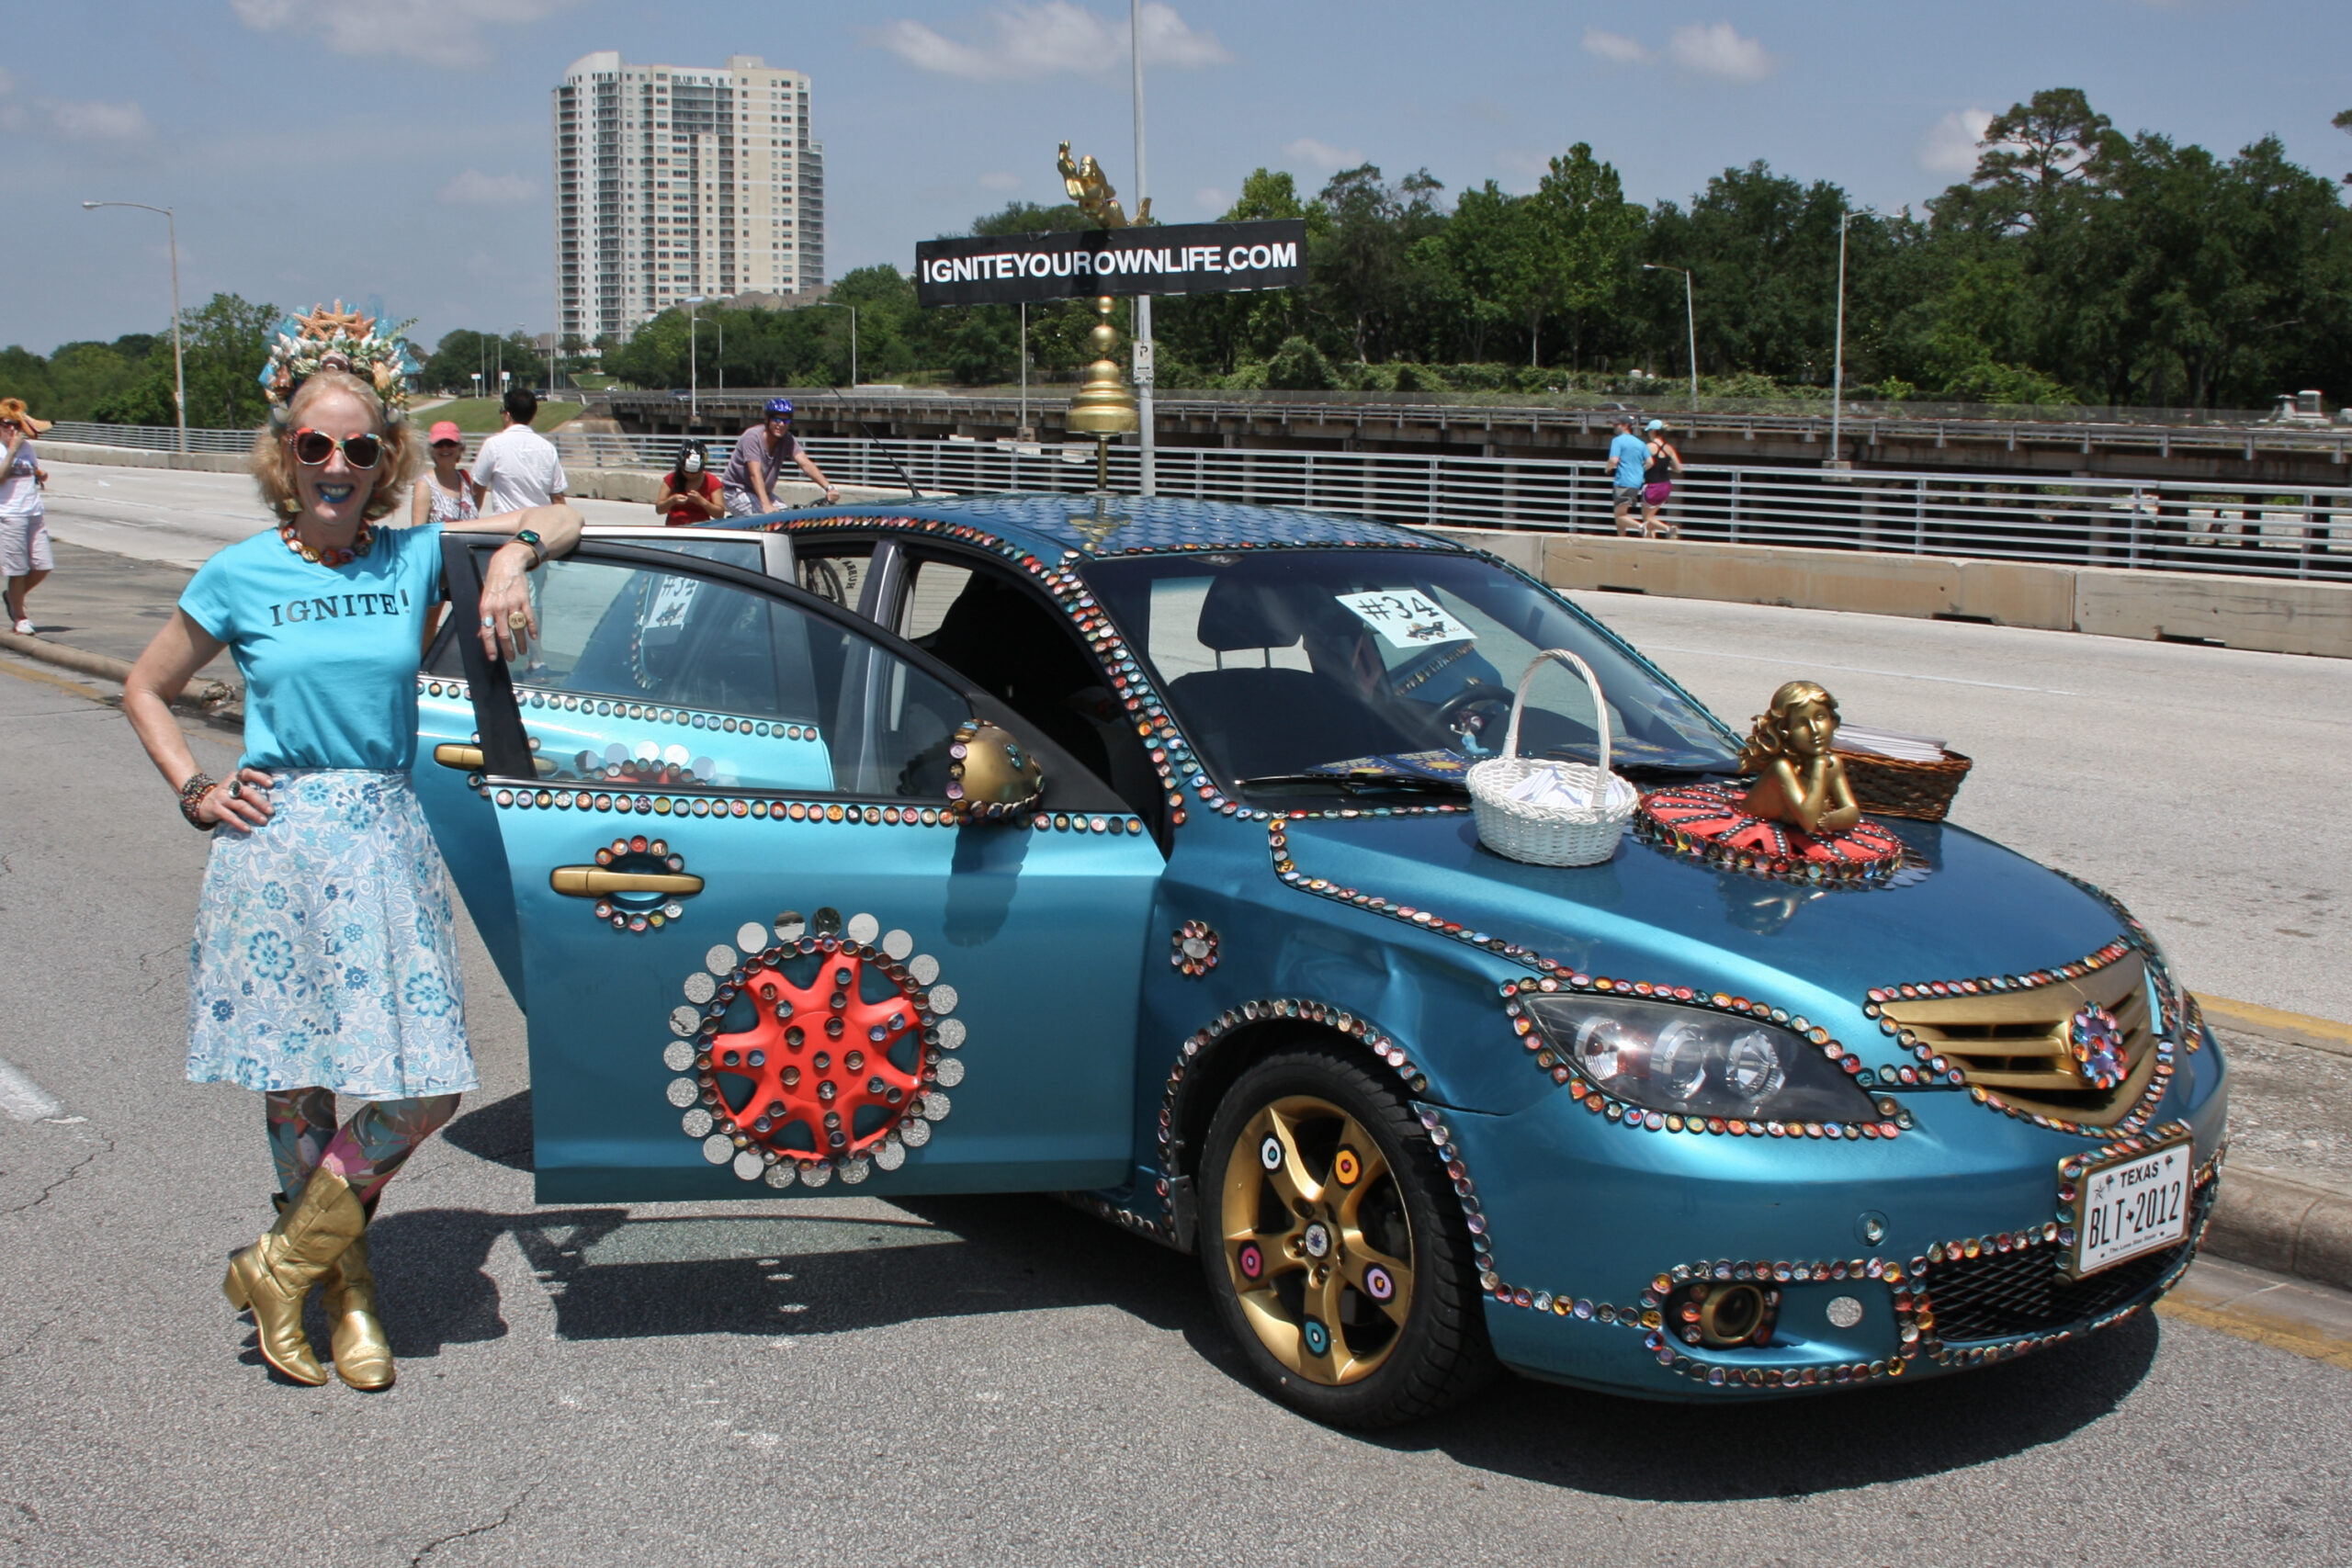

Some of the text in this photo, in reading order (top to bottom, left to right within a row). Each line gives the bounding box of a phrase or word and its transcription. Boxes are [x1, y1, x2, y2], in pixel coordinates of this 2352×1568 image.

[923, 243, 1297, 284] IGNITEYOUROWNLIFE.COM
[269, 589, 411, 626] IGNITE!
[1357, 596, 1440, 620] #34
[2120, 1161, 2159, 1188] TEXAS
